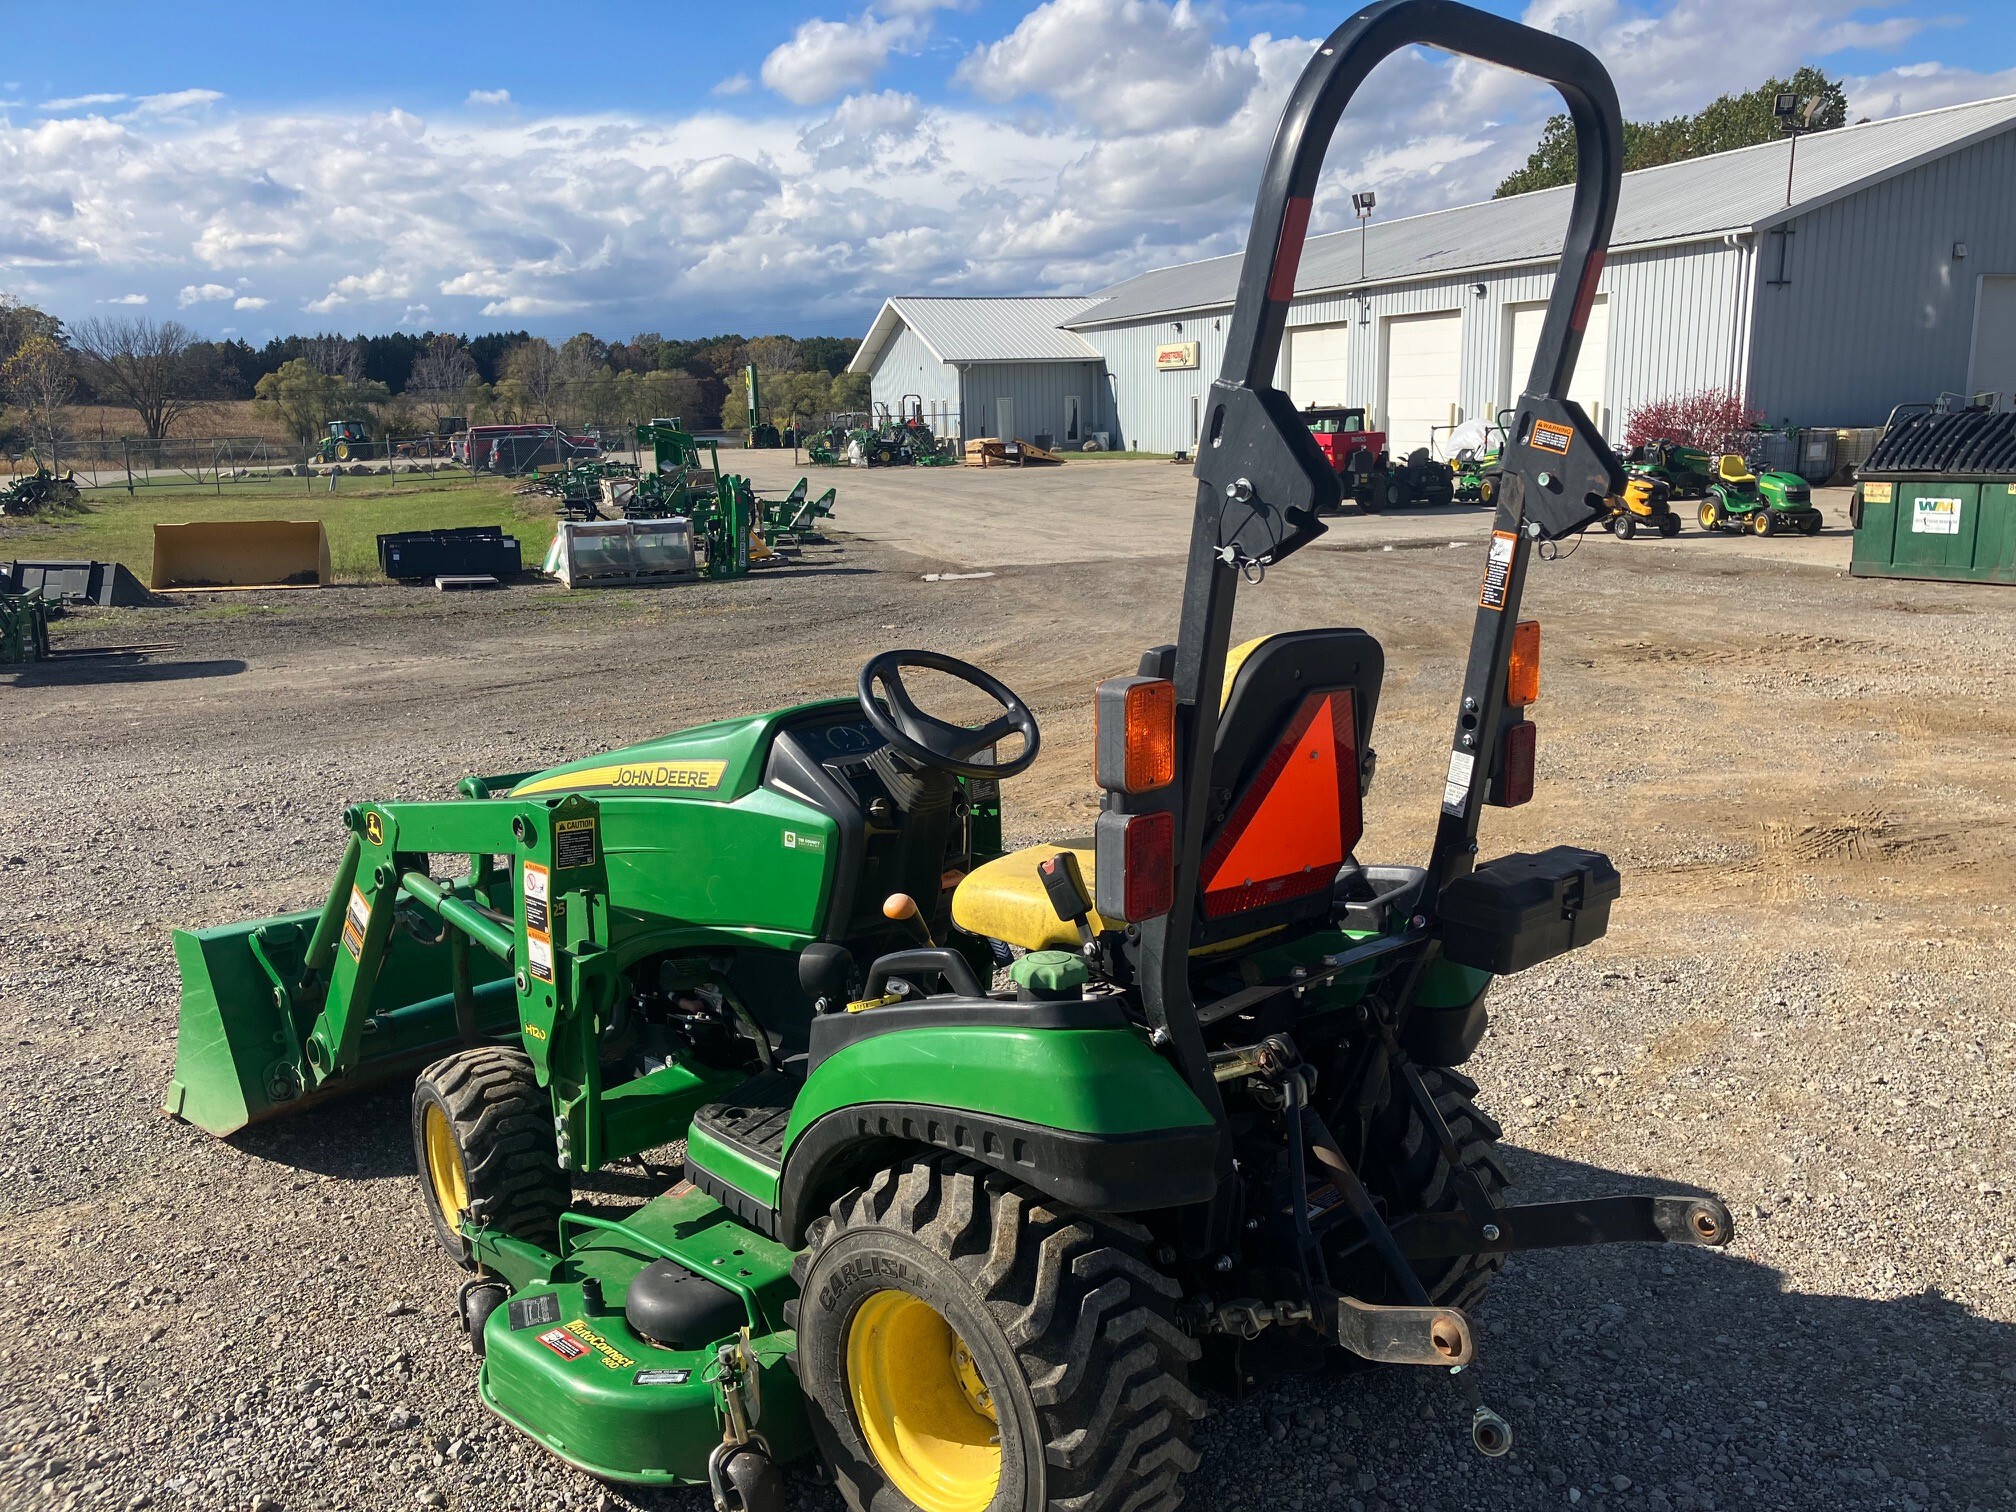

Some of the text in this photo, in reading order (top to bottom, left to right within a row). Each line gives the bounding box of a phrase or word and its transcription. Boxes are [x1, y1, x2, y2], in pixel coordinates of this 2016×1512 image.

[1543, 423, 1571, 435] WARNING
[613, 767, 709, 786] JOHN DEERE
[566, 820, 593, 830] CAUTION
[819, 1256, 935, 1312] CARLISLE
[564, 1319, 635, 1368] AutoConnect
[601, 1357, 620, 1369] 60D
